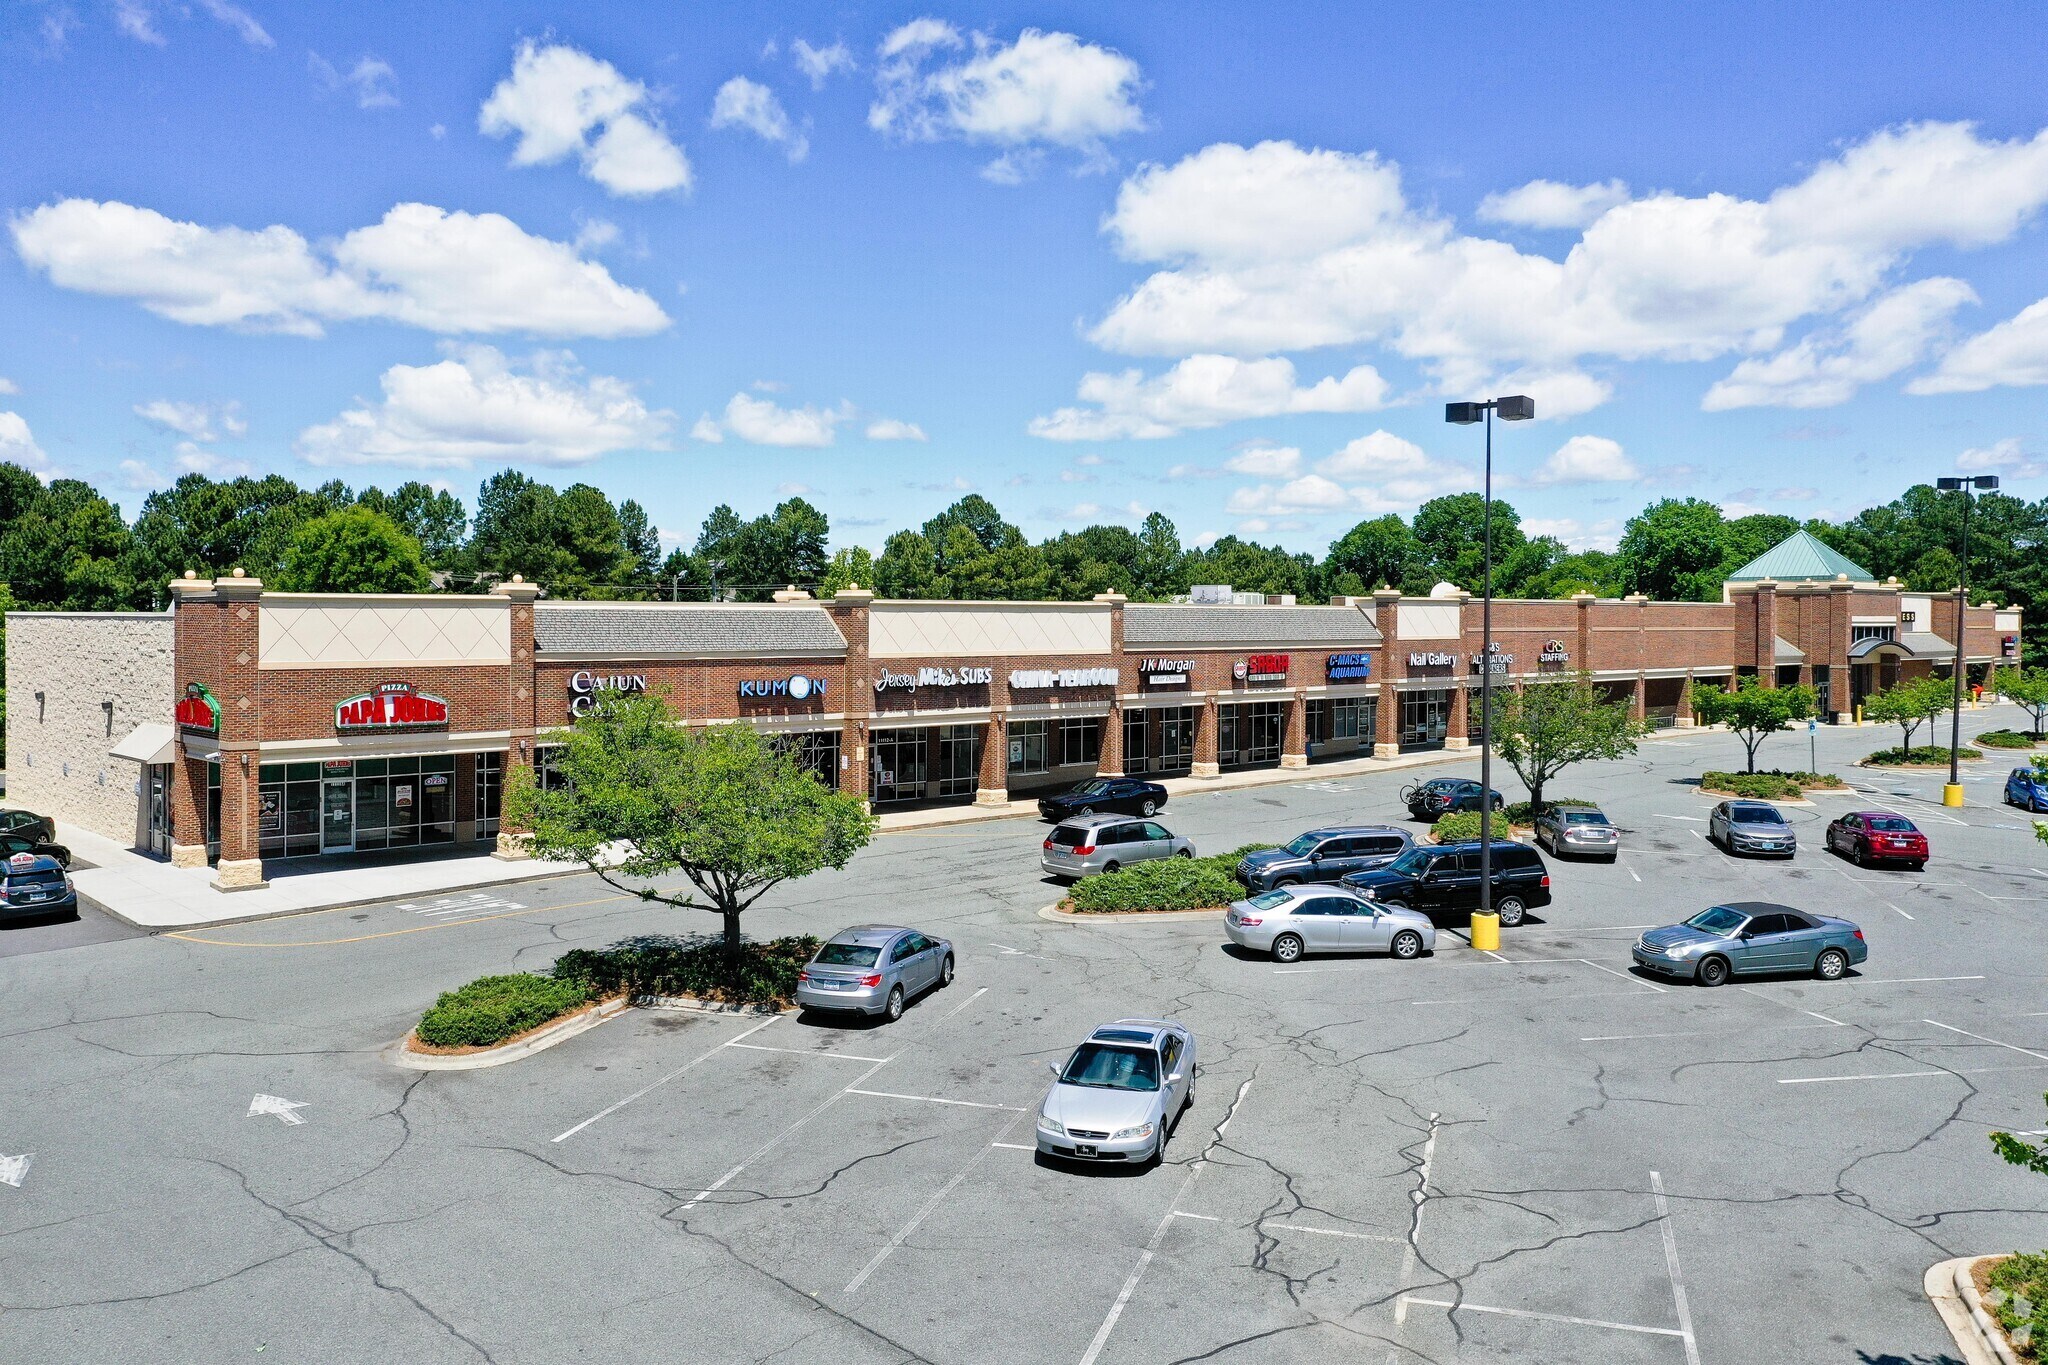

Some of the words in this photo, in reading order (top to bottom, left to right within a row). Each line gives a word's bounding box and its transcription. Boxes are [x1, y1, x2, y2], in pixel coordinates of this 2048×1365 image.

[1329, 654, 1360, 666] C-MACS
[1410, 652, 1426, 666] Nail
[1428, 652, 1457, 668] Gallery
[1472, 654, 1514, 665] ALTATIONS
[1540, 653, 1569, 662] STAFFING
[1157, 658, 1195, 673] Morgan
[1329, 666, 1371, 679] AQUARIUM
[875, 668, 916, 693] Jersey
[917, 667, 958, 687] Mike's
[958, 666, 993, 685] SUBS
[380, 683, 408, 692] PIZZA
[739, 675, 827, 700] KUMON
[339, 697, 386, 725] PAPA
